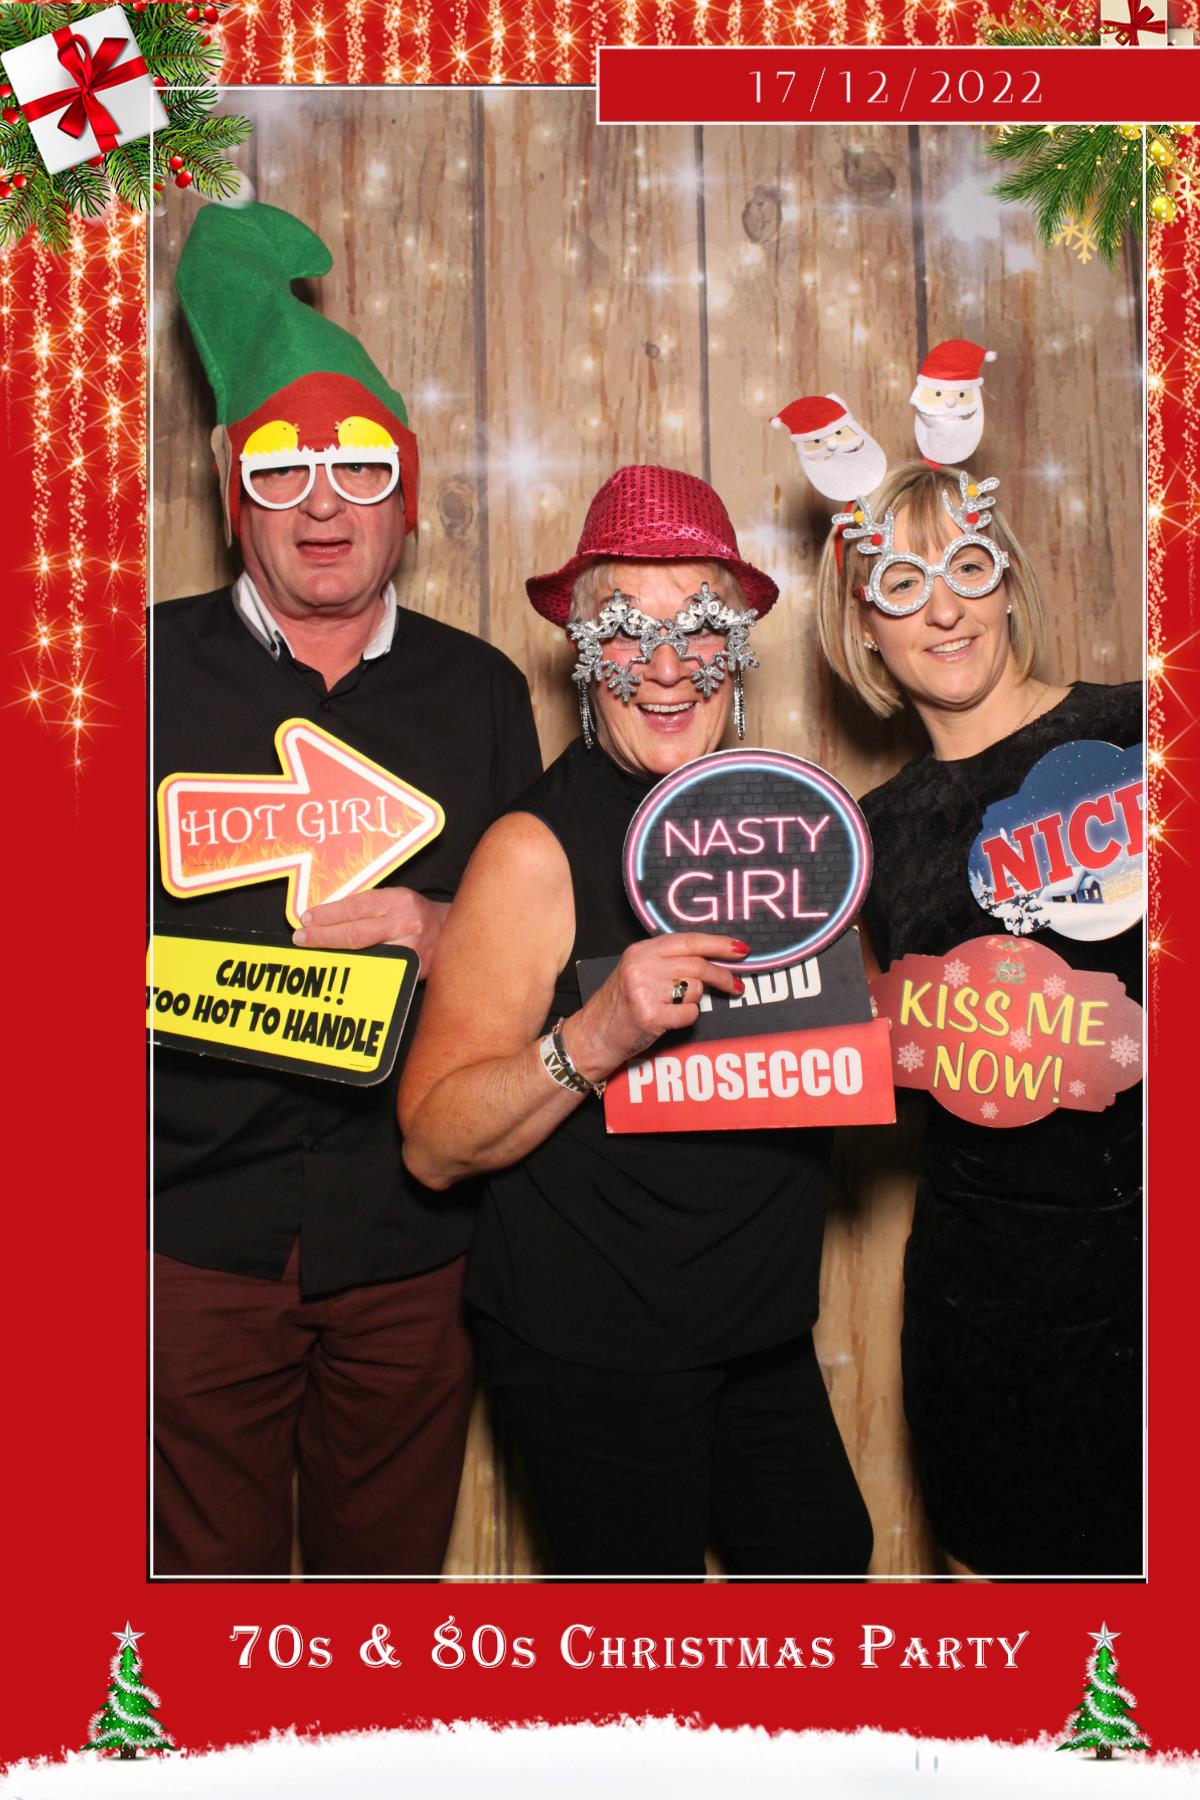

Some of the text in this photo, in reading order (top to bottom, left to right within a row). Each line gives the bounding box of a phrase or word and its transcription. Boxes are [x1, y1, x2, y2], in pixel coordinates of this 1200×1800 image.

[181, 795, 401, 847] HOT GIRL
[664, 814, 830, 858] NASTY
[666, 868, 830, 922] GIRL
[215, 959, 351, 1006] CAUTION!!
[192, 994, 247, 1028] HOT
[248, 1001, 280, 1035] TO
[282, 1009, 384, 1058] HANDLE
[899, 979, 1109, 1047] KISS ME
[626, 1047, 864, 1104] PROSECCO
[932, 1041, 1064, 1104] NOW!
